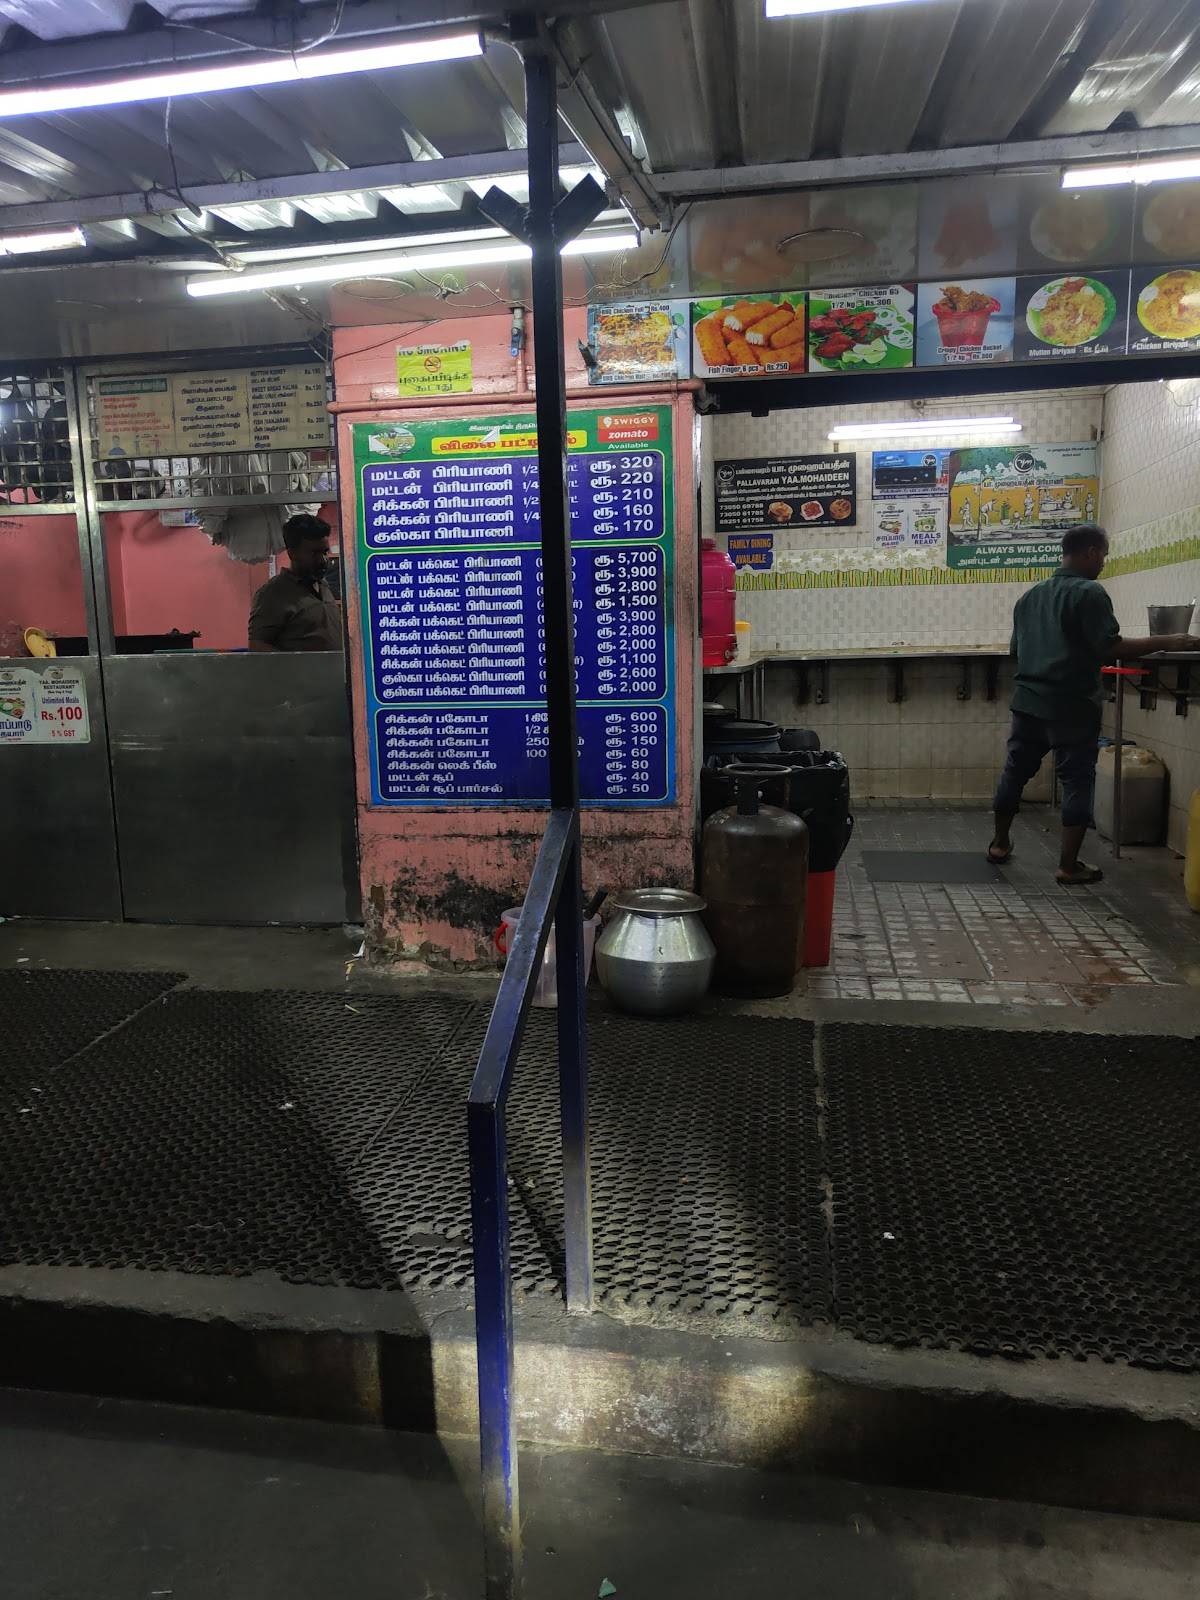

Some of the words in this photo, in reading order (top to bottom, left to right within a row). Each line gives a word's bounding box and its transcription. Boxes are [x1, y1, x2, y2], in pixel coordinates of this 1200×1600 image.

[614, 416, 655, 425] SWIGGY
[439, 439, 496, 451] விலை
[500, 432, 577, 450] பட்டில்
[608, 430, 649, 439] zomato
[607, 442, 649, 450] Available
[370, 468, 422, 480] மட்டன்
[432, 464, 513, 477] பிரியாணி
[620, 456, 653, 468] 320
[371, 483, 423, 496] மட்டன்
[433, 479, 513, 493] பிரியாணி
[620, 472, 654, 484] 220
[737, 478, 779, 487] PALLAVARAM
[372, 499, 431, 511] சிக்கன்
[433, 495, 514, 508] பிரியாணி
[621, 488, 653, 500] 210
[372, 514, 431, 526] சிக்கன்
[434, 510, 514, 523] பிரியாணி
[622, 504, 654, 516] 160
[373, 529, 431, 543] குஸ்கா
[434, 526, 514, 538] பிரியாணி
[623, 520, 654, 531] 170
[911, 532, 941, 540] MEALS
[730, 539, 750, 549] FAMILY
[976, 545, 1014, 554] ALWAYS
[1017, 544, 1063, 553] WELCOM
[375, 559, 413, 570] மட்டன்
[417, 558, 460, 569] பக்கெட்
[463, 556, 522, 568] பிரியாணி
[617, 552, 657, 564] 5,700
[736, 554, 767, 564] AVAILABLE
[957, 556, 1000, 567] அன்புடன்
[377, 574, 414, 584] மட்டன்
[417, 573, 461, 583] பக்கெட்
[464, 571, 522, 582] பிரியாணி
[617, 566, 657, 578] 3,900
[377, 588, 415, 599] மட்டன்
[418, 587, 461, 598] பக்கெட்
[465, 585, 523, 596] பிரியாணி
[618, 580, 657, 593] 2,800
[378, 602, 415, 613] மட்டன்
[419, 602, 461, 612] பக்கெட்
[465, 600, 523, 610] பிரியாணி
[619, 595, 657, 607] 1,500
[378, 616, 421, 627] சிக்கன்
[422, 616, 465, 626] பக்கெட்
[466, 614, 524, 625] பிரியாணி
[619, 610, 656, 622] 3,900
[379, 630, 421, 641] சிக்கன்
[423, 630, 465, 640] பக்கெட்
[467, 628, 525, 639] பிரியாணி
[619, 625, 657, 637] 2,800
[380, 644, 422, 655] சிக்கன்
[423, 644, 467, 654] பக்கெட்
[467, 642, 525, 653] பிரியாணி
[619, 639, 657, 651] 2,000
[381, 658, 423, 669] சிக்கன்
[424, 658, 467, 668] பக்கெட்
[468, 656, 525, 667] பிரியாணி
[619, 653, 657, 665] 1,100
[381, 672, 423, 684] குஸ்கா
[425, 672, 467, 682] பக்கெட்
[468, 671, 525, 681] பிரியாணி
[619, 667, 657, 679] 2,600
[382, 686, 424, 698] குஸ்கா
[425, 686, 468, 696] பக்கெட்
[469, 685, 526, 695] பிரியாணி
[619, 682, 657, 693] 2,000
[41, 706, 83, 720] Rs.100
[384, 714, 433, 723] சிக்கன்
[435, 714, 489, 722] பகோடா
[630, 712, 657, 721] 600
[385, 726, 434, 735] சிக்கன்
[436, 726, 489, 734] பகோடா
[631, 724, 658, 733] 300
[385, 738, 434, 746] சிக்கன்
[436, 737, 489, 746] பகோடா
[631, 736, 658, 745] 150
[386, 750, 435, 758] சிக்கன்
[437, 749, 490, 758] பகோடா
[630, 748, 649, 757] 60
[387, 761, 435, 770] சிக்கன்
[631, 760, 649, 769] 80
[387, 772, 430, 781] மட்டன்
[631, 772, 649, 780] 40
[388, 784, 431, 792] மட்டன்
[631, 784, 650, 792] 50
